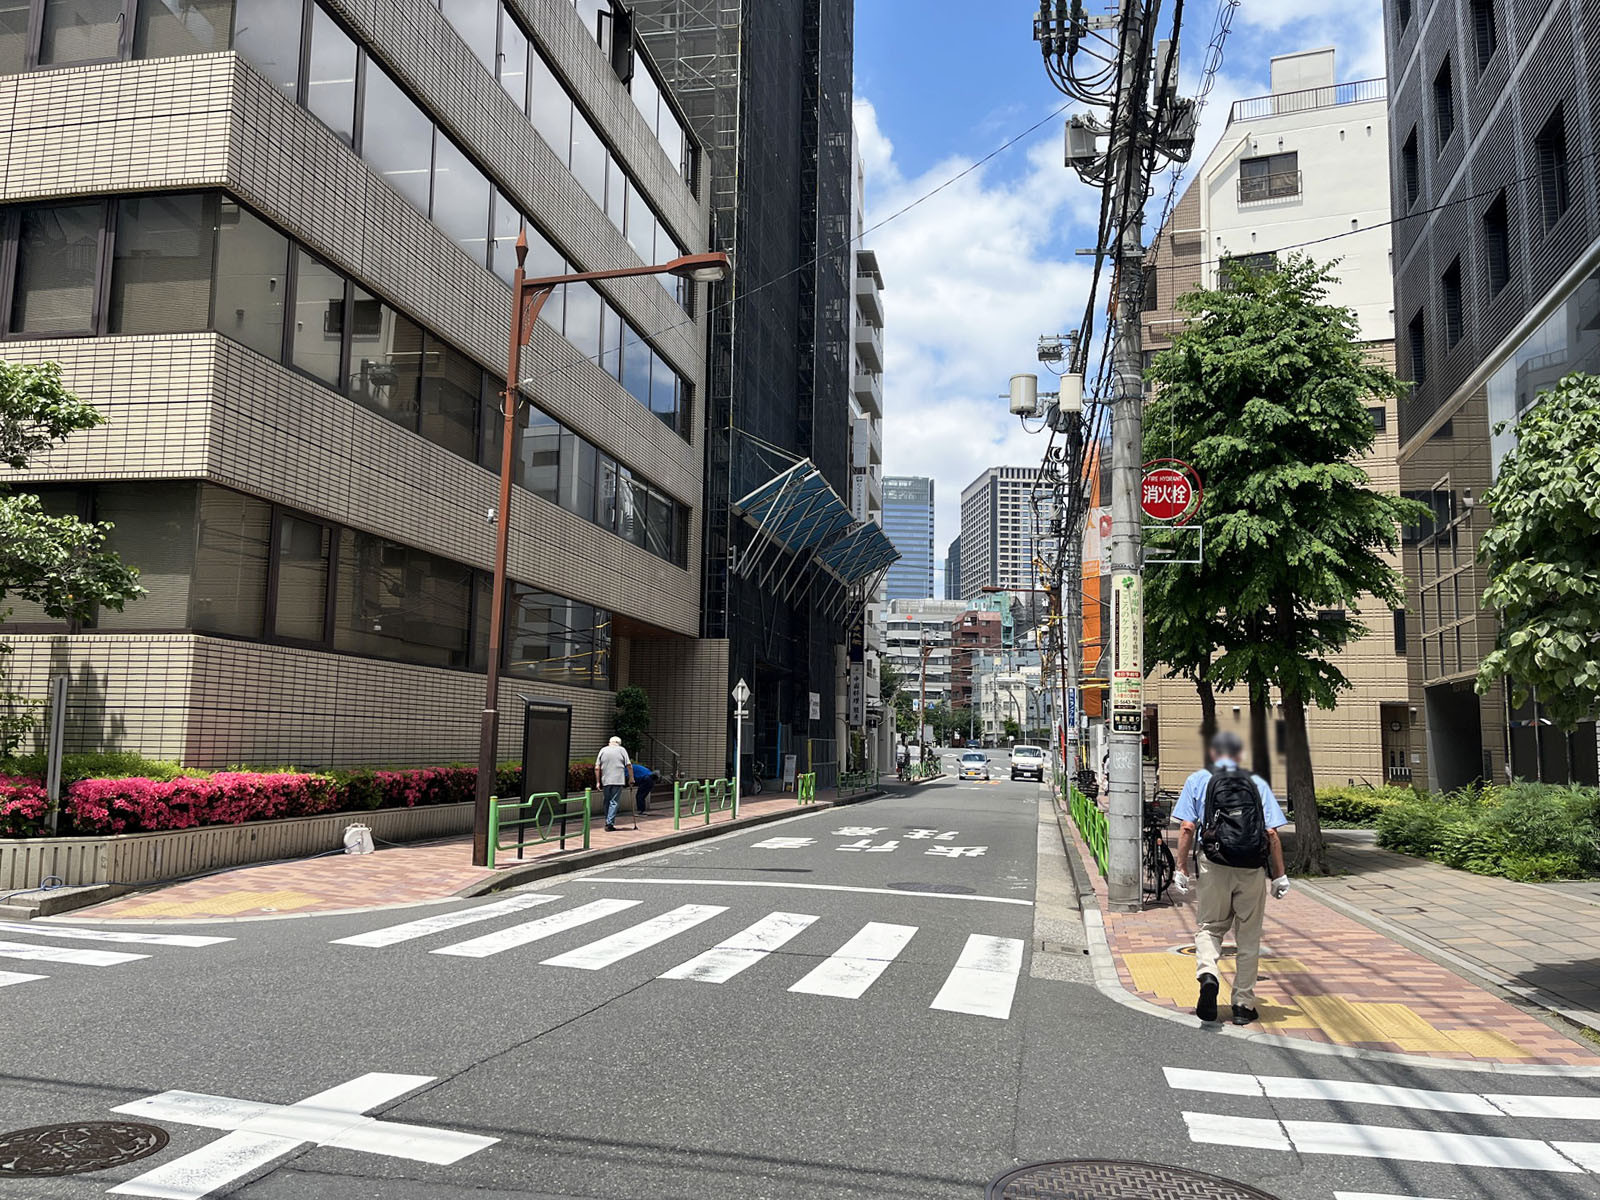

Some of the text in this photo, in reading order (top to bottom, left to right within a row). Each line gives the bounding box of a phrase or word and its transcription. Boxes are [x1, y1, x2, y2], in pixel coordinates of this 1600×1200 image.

[1143, 485, 1187, 504] 消火栓
[1121, 589, 1130, 669] こころのケアクリニック
[831, 826, 959, 841] 注意
